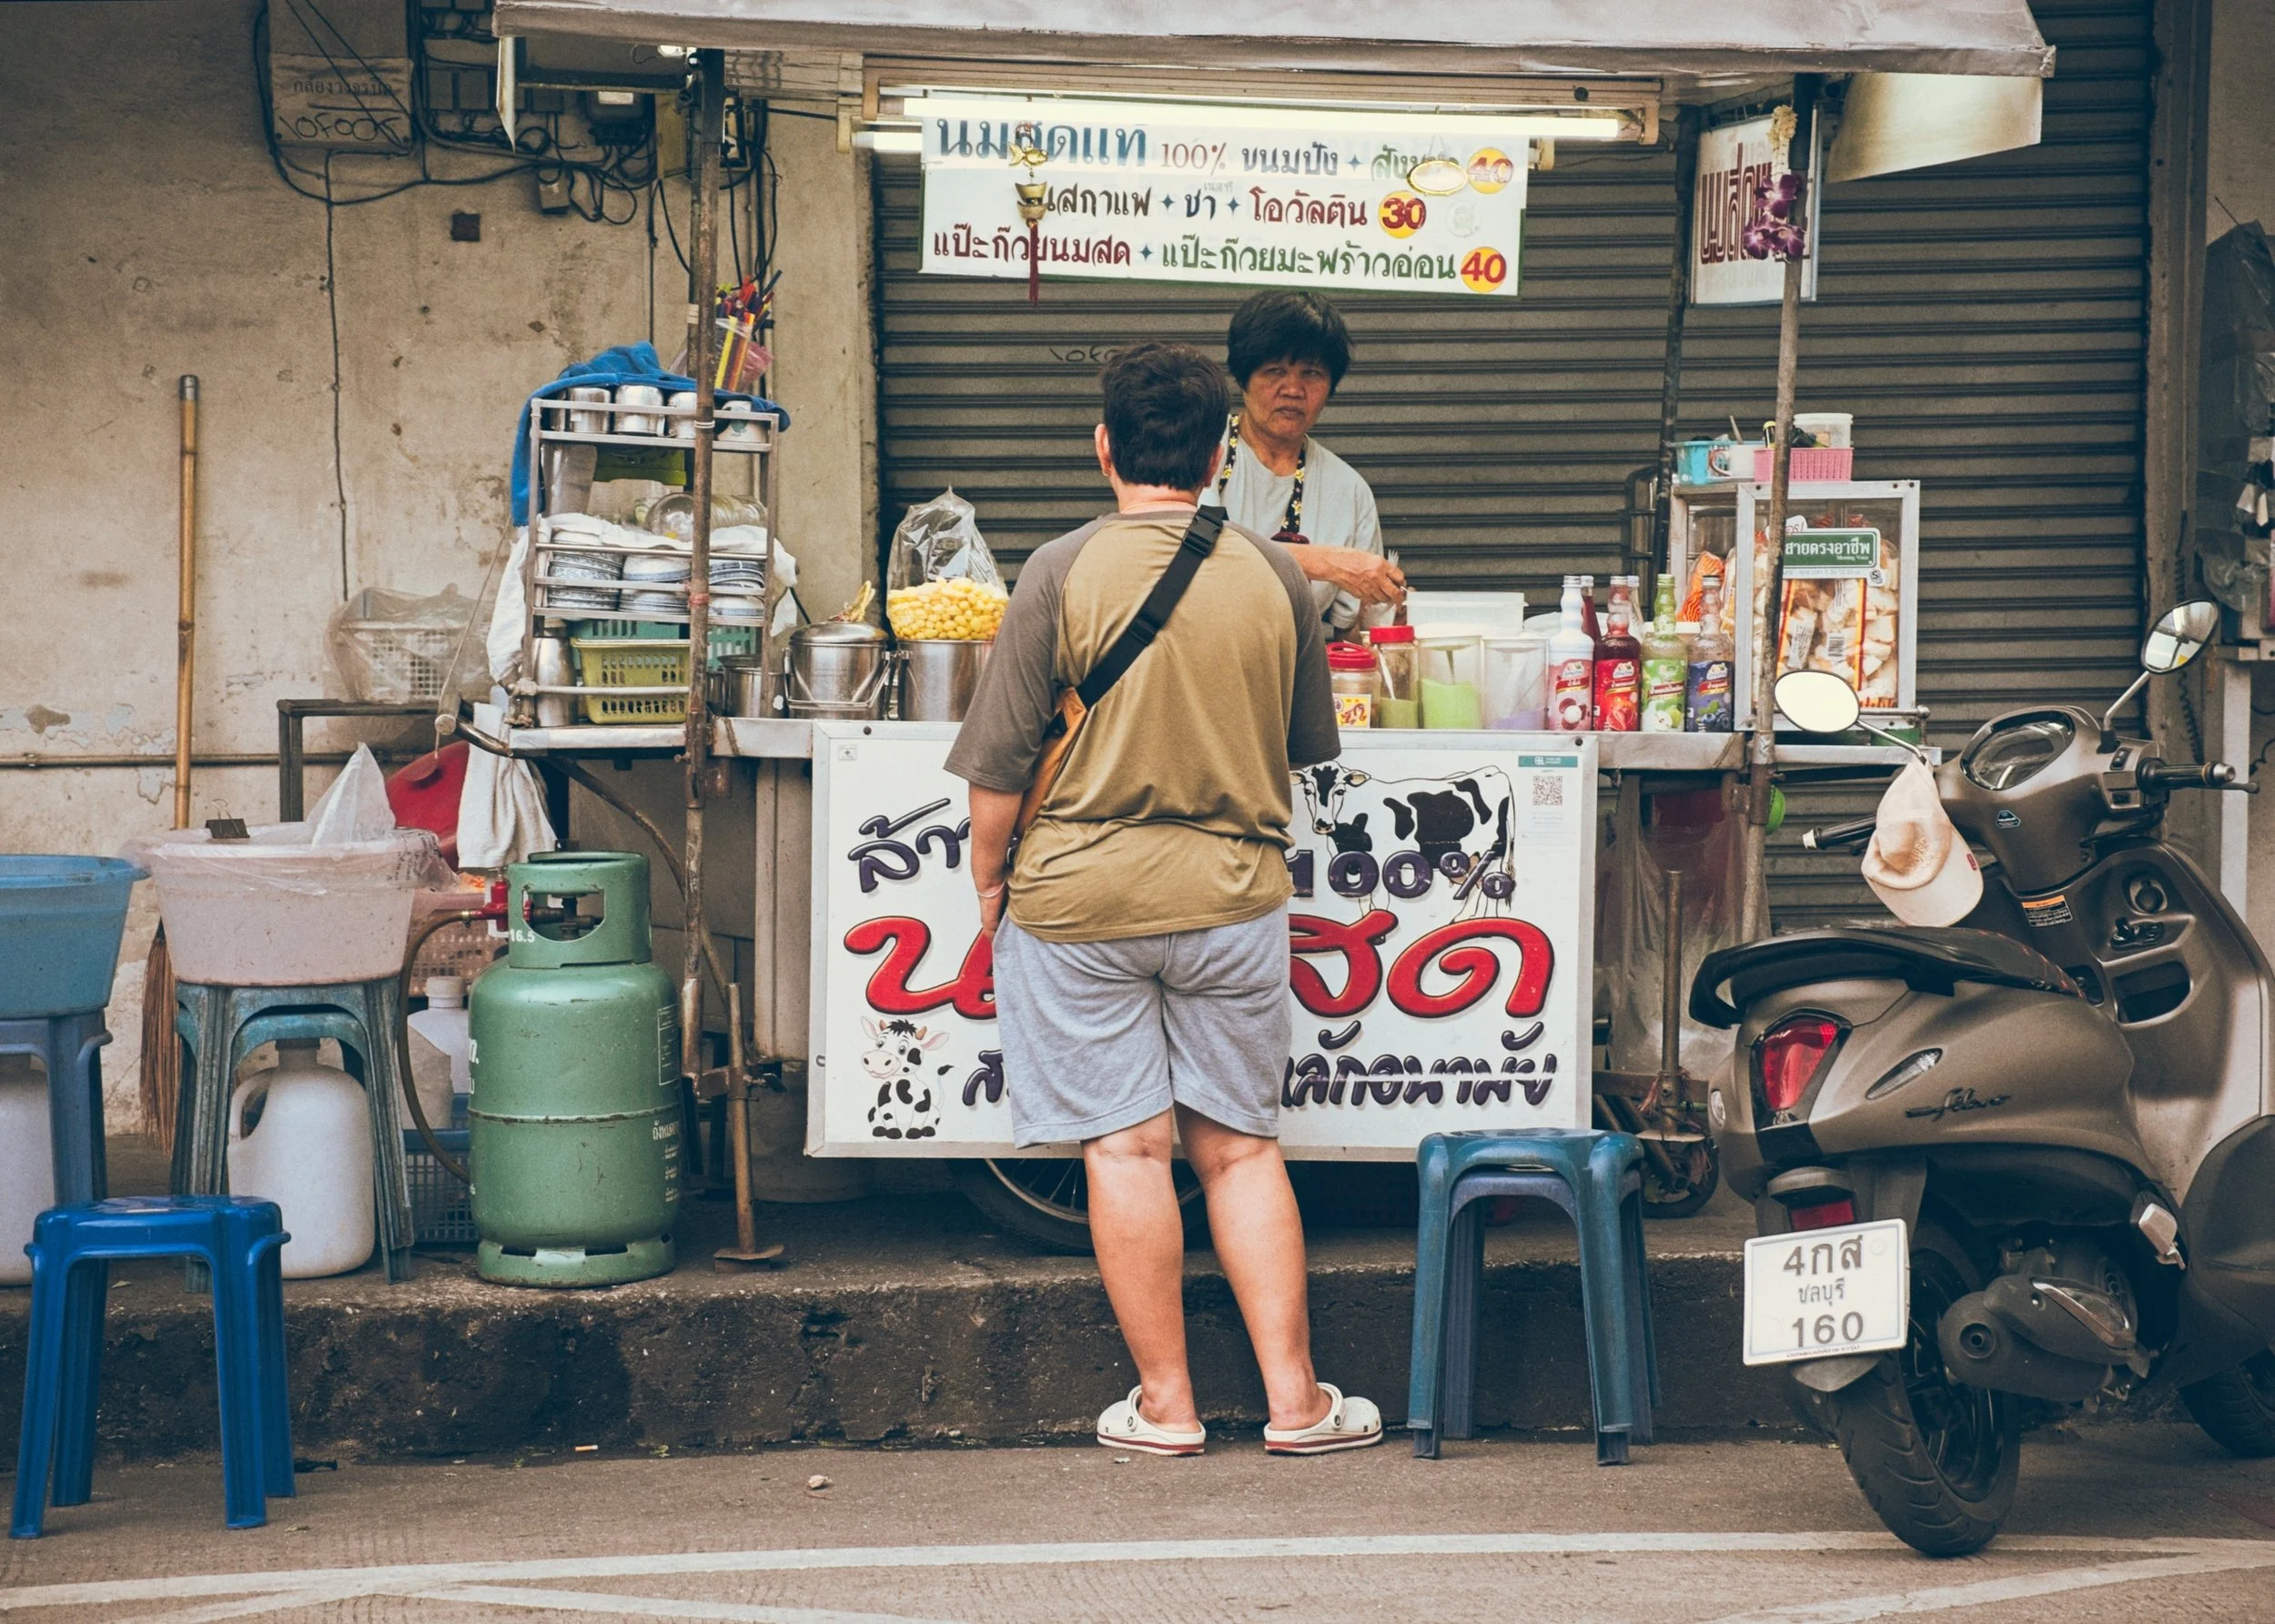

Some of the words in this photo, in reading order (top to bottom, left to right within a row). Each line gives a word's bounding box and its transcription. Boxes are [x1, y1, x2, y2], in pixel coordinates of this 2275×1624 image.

[1161, 140, 1227, 176] 100%
[1241, 141, 1339, 177] ขนมปัง
[1467, 156, 1514, 184] 40
[1185, 187, 1216, 220] ชา
[1249, 186, 1368, 228] โอวัลติน
[1382, 197, 1427, 229] 30
[934, 222, 1131, 267] แป๊ะก๊วยนมสด
[1162, 233, 1457, 280] แป๊ะก๊วยมะพร้าวอ่อน
[1461, 251, 1507, 283] 40
[1286, 850, 1516, 900] 100%
[510, 929, 535, 943] 16.5
[1783, 1235, 1864, 1276] 4กส
[1798, 1277, 1845, 1306] ชลบุรี
[1792, 1311, 1864, 1347] 160
